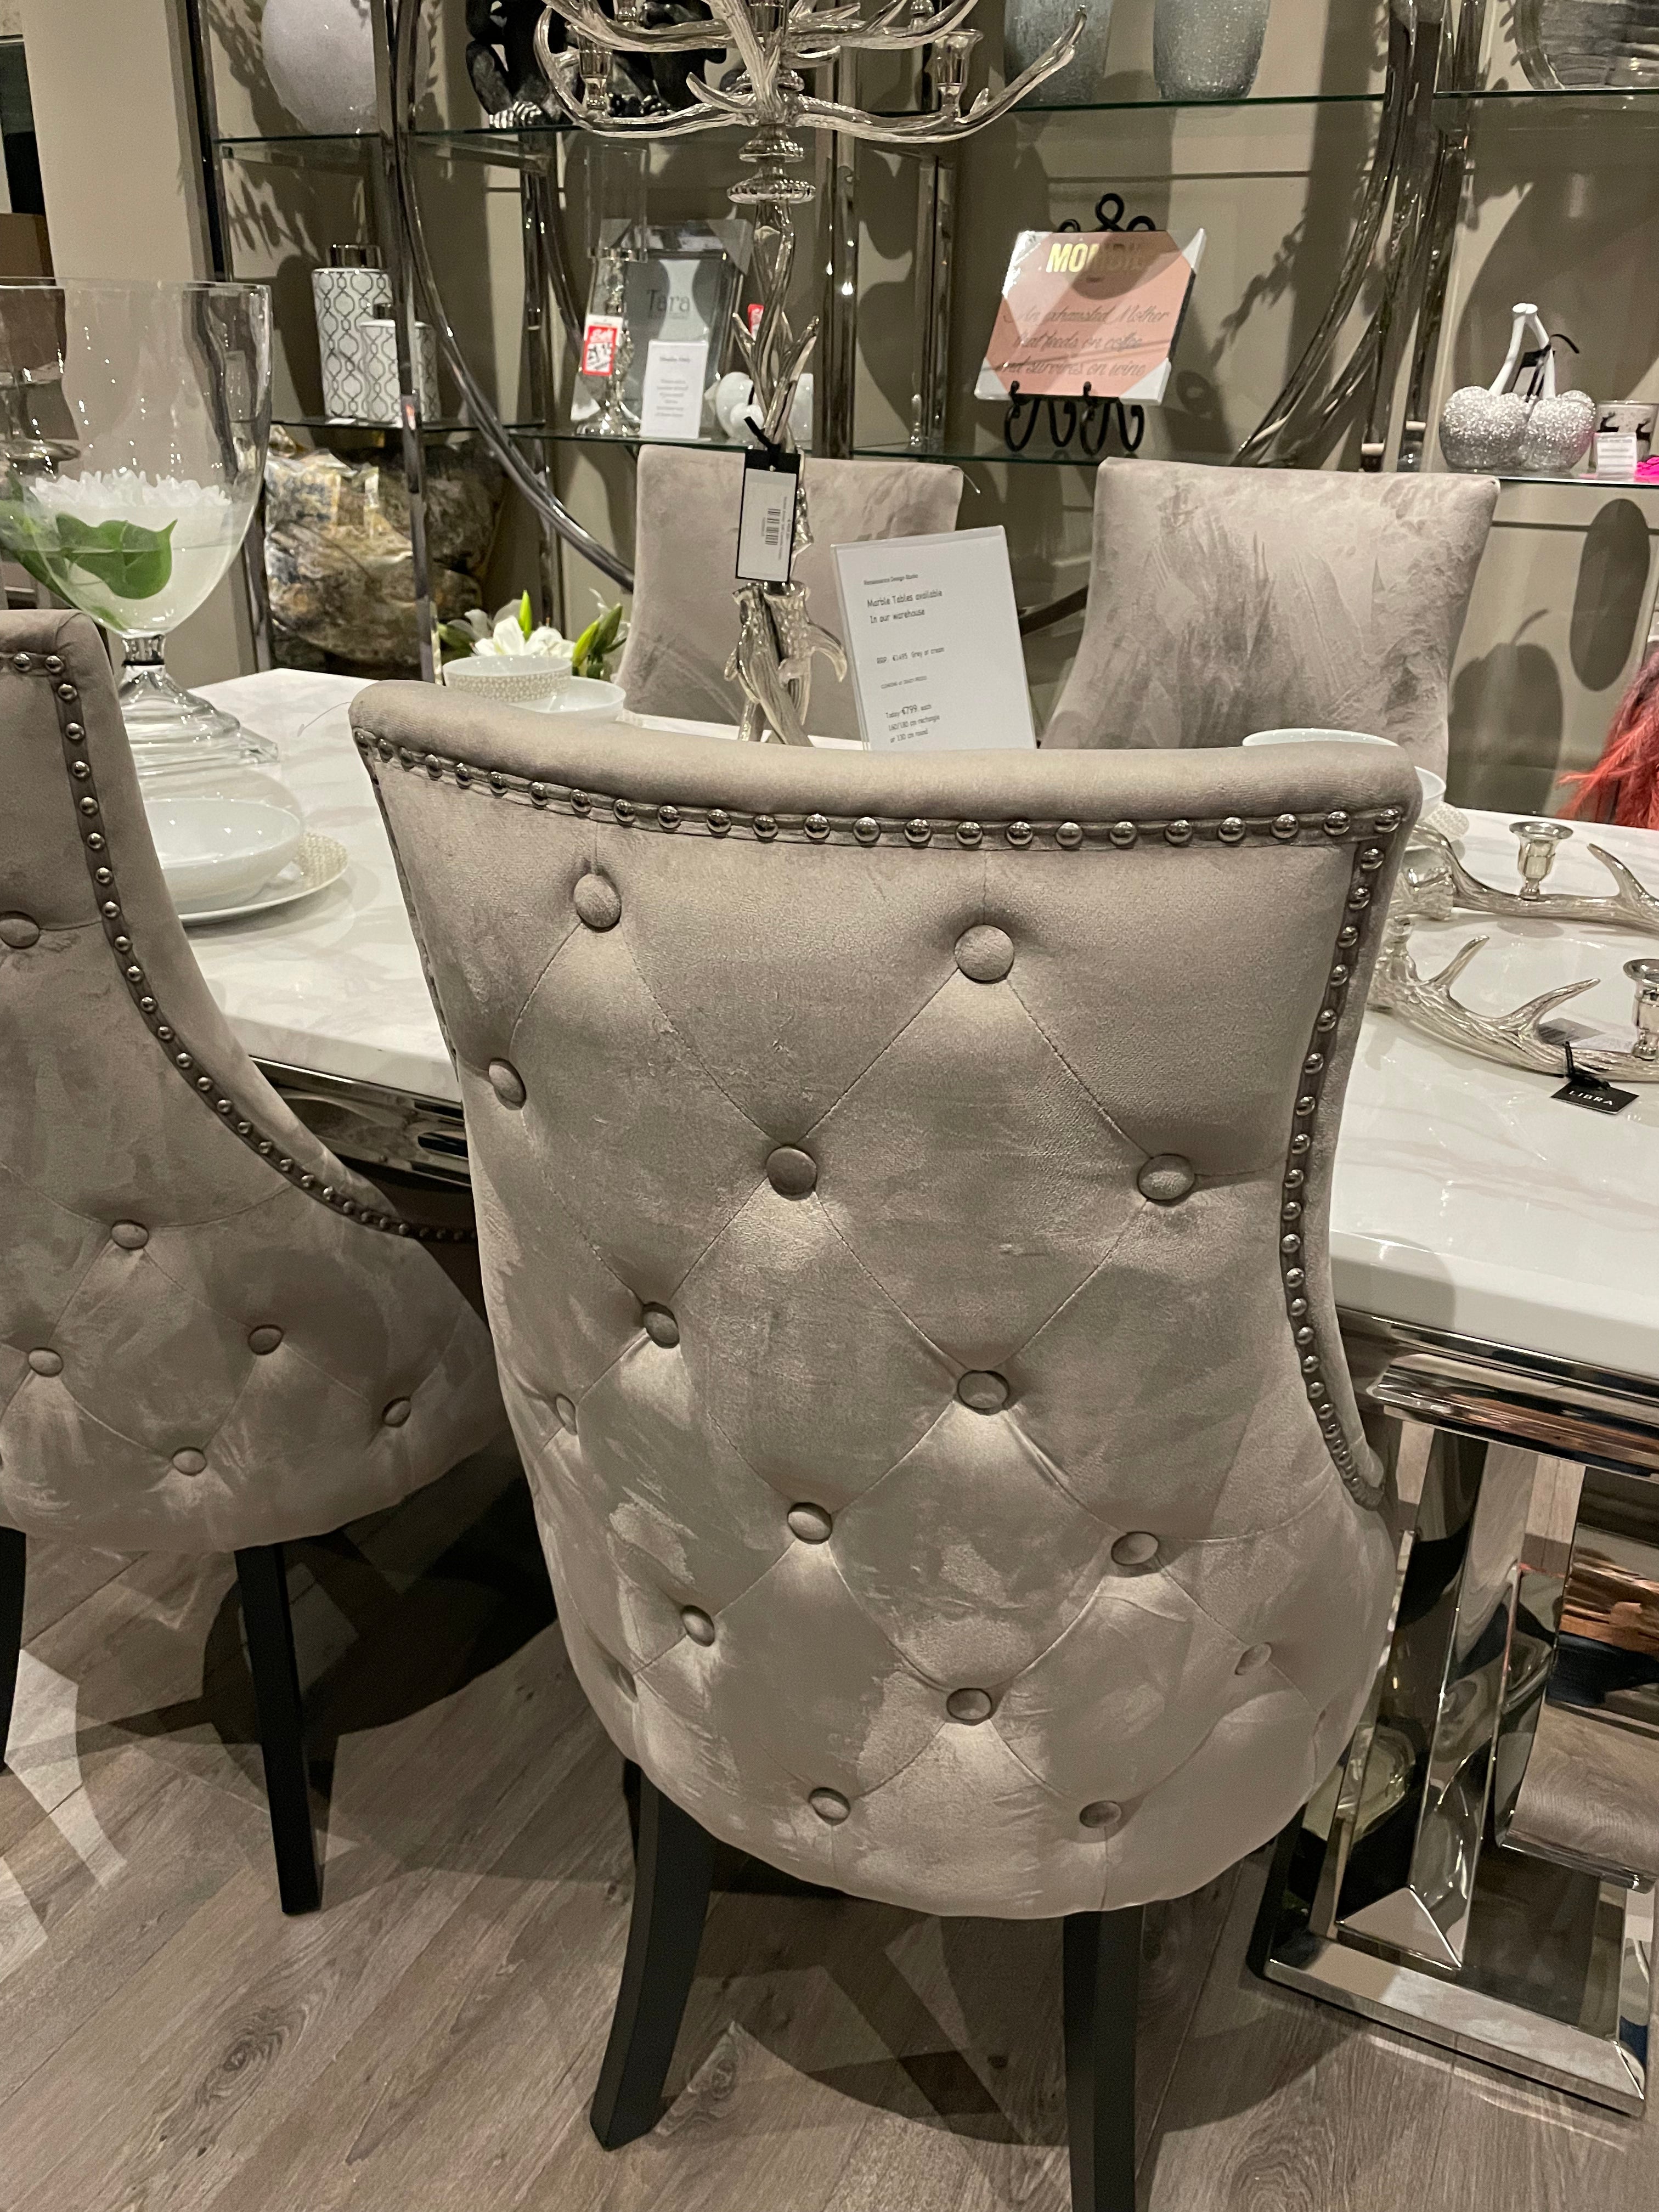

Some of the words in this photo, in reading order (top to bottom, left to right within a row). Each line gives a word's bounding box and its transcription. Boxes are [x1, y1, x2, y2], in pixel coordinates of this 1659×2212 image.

[867, 596, 890, 608] Marble
[891, 594, 913, 604] Tables
[916, 589, 943, 600] available
[880, 614, 890, 623] our
[893, 609, 925, 620] warehouse
[901, 704, 917, 715] €799
[1568, 1090, 1613, 1106] LIBRA
